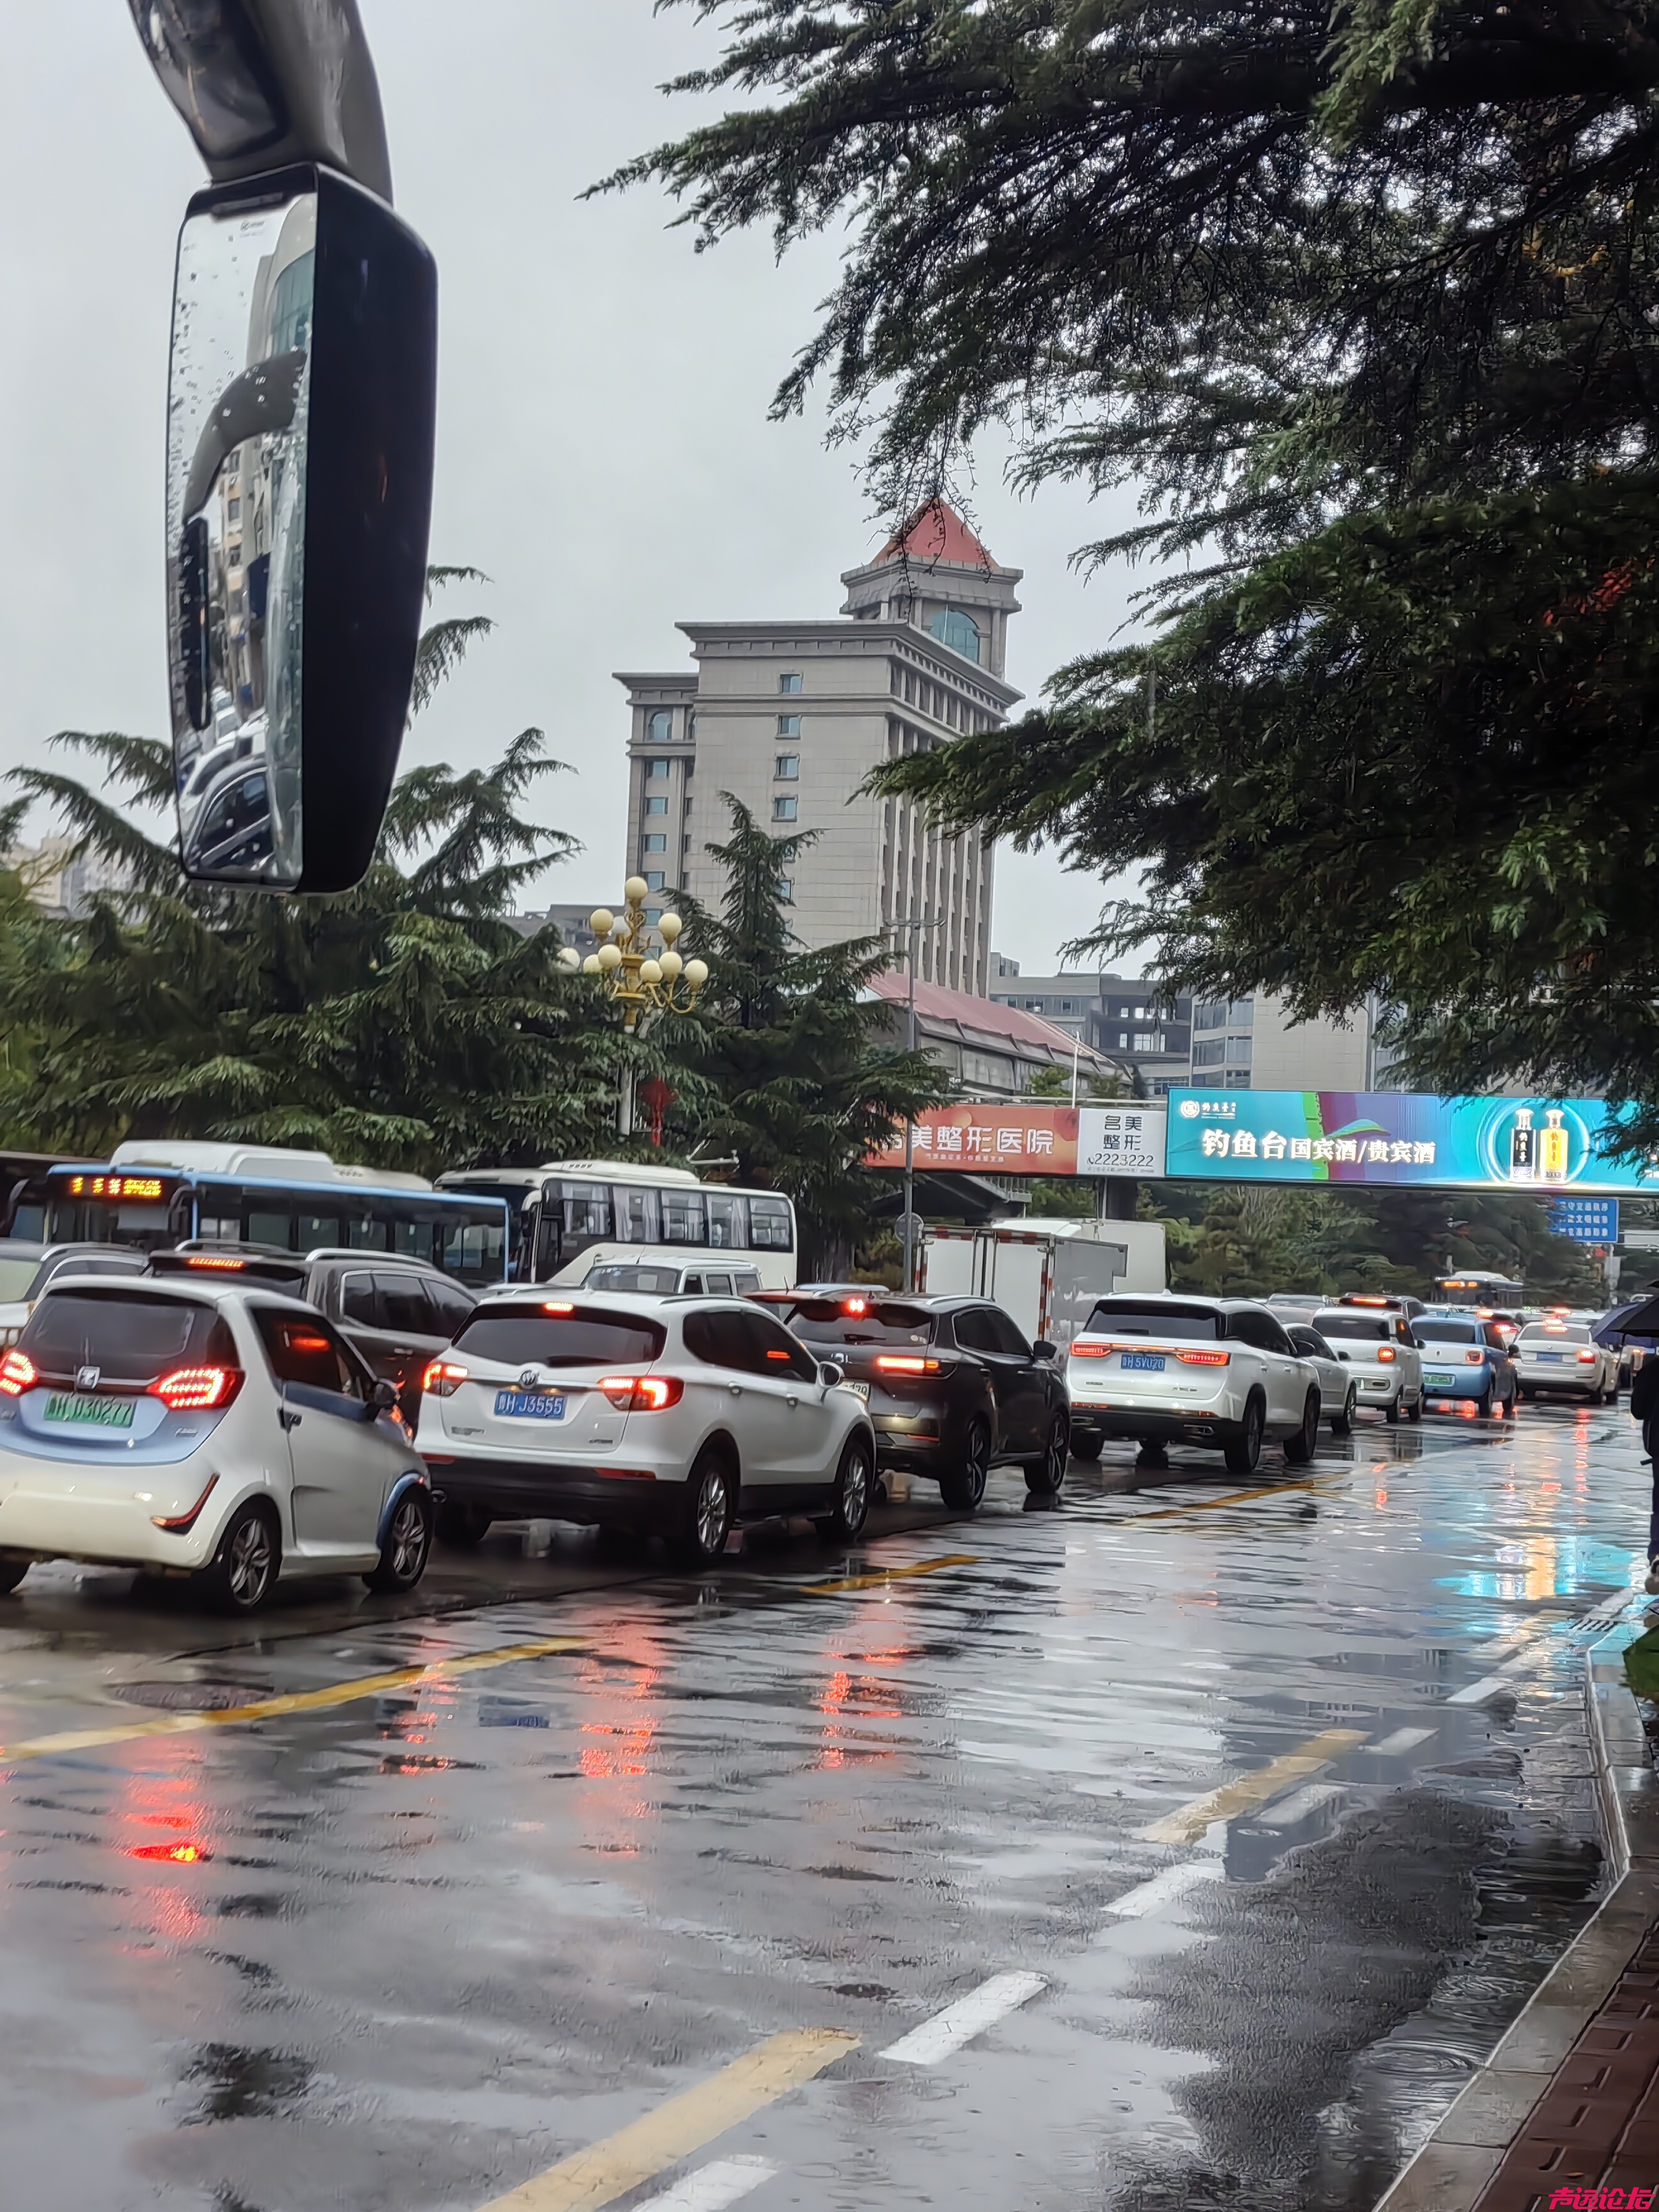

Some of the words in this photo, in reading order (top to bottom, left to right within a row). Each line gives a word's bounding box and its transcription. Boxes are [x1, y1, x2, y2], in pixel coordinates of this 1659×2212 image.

[1104, 1115, 1142, 1131] 名美
[1103, 1134, 1142, 1150] 整形
[1202, 1129, 1436, 1164] 钓鱼台国宾酒/贵宾酒
[1095, 1153, 1154, 1167] 2223222
